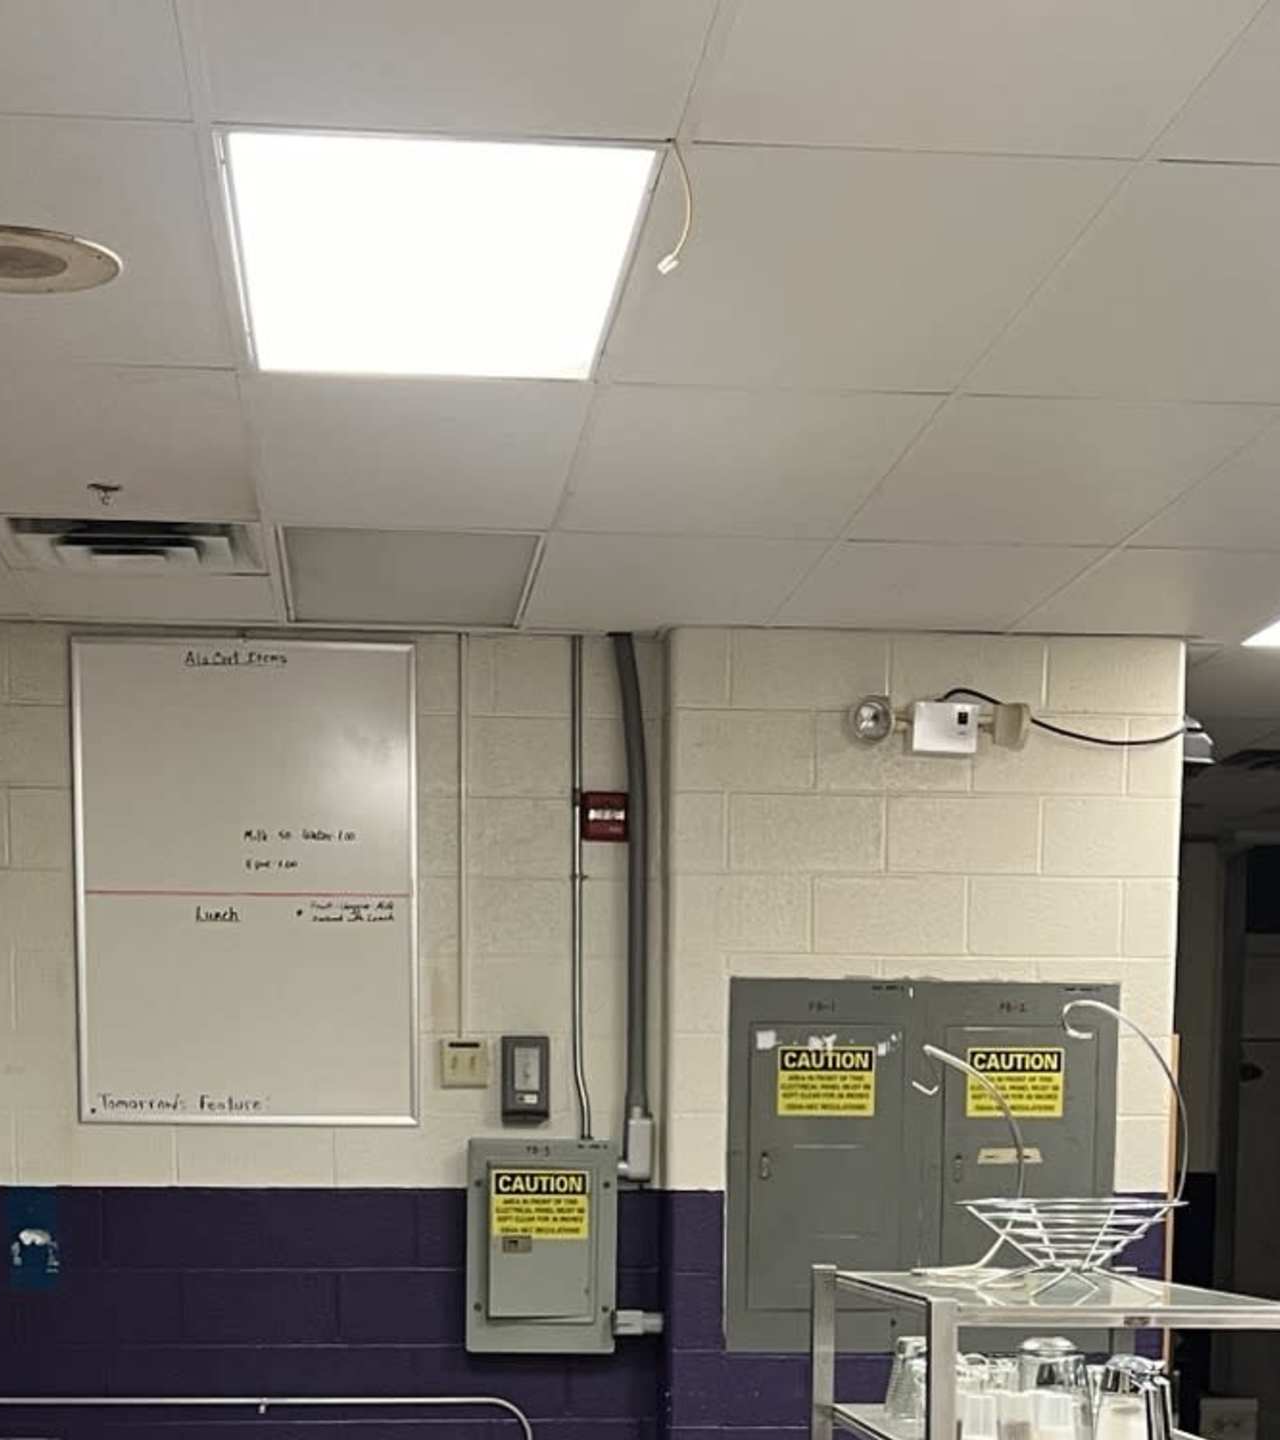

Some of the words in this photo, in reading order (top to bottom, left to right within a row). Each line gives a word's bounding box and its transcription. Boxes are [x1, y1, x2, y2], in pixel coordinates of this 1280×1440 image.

[195, 904, 241, 923] Lunch
[783, 1052, 869, 1069] CAUTION
[973, 1053, 1058, 1070] CAUTION
[199, 1094, 262, 1112] Feature
[498, 1175, 583, 1193] CAUTION
